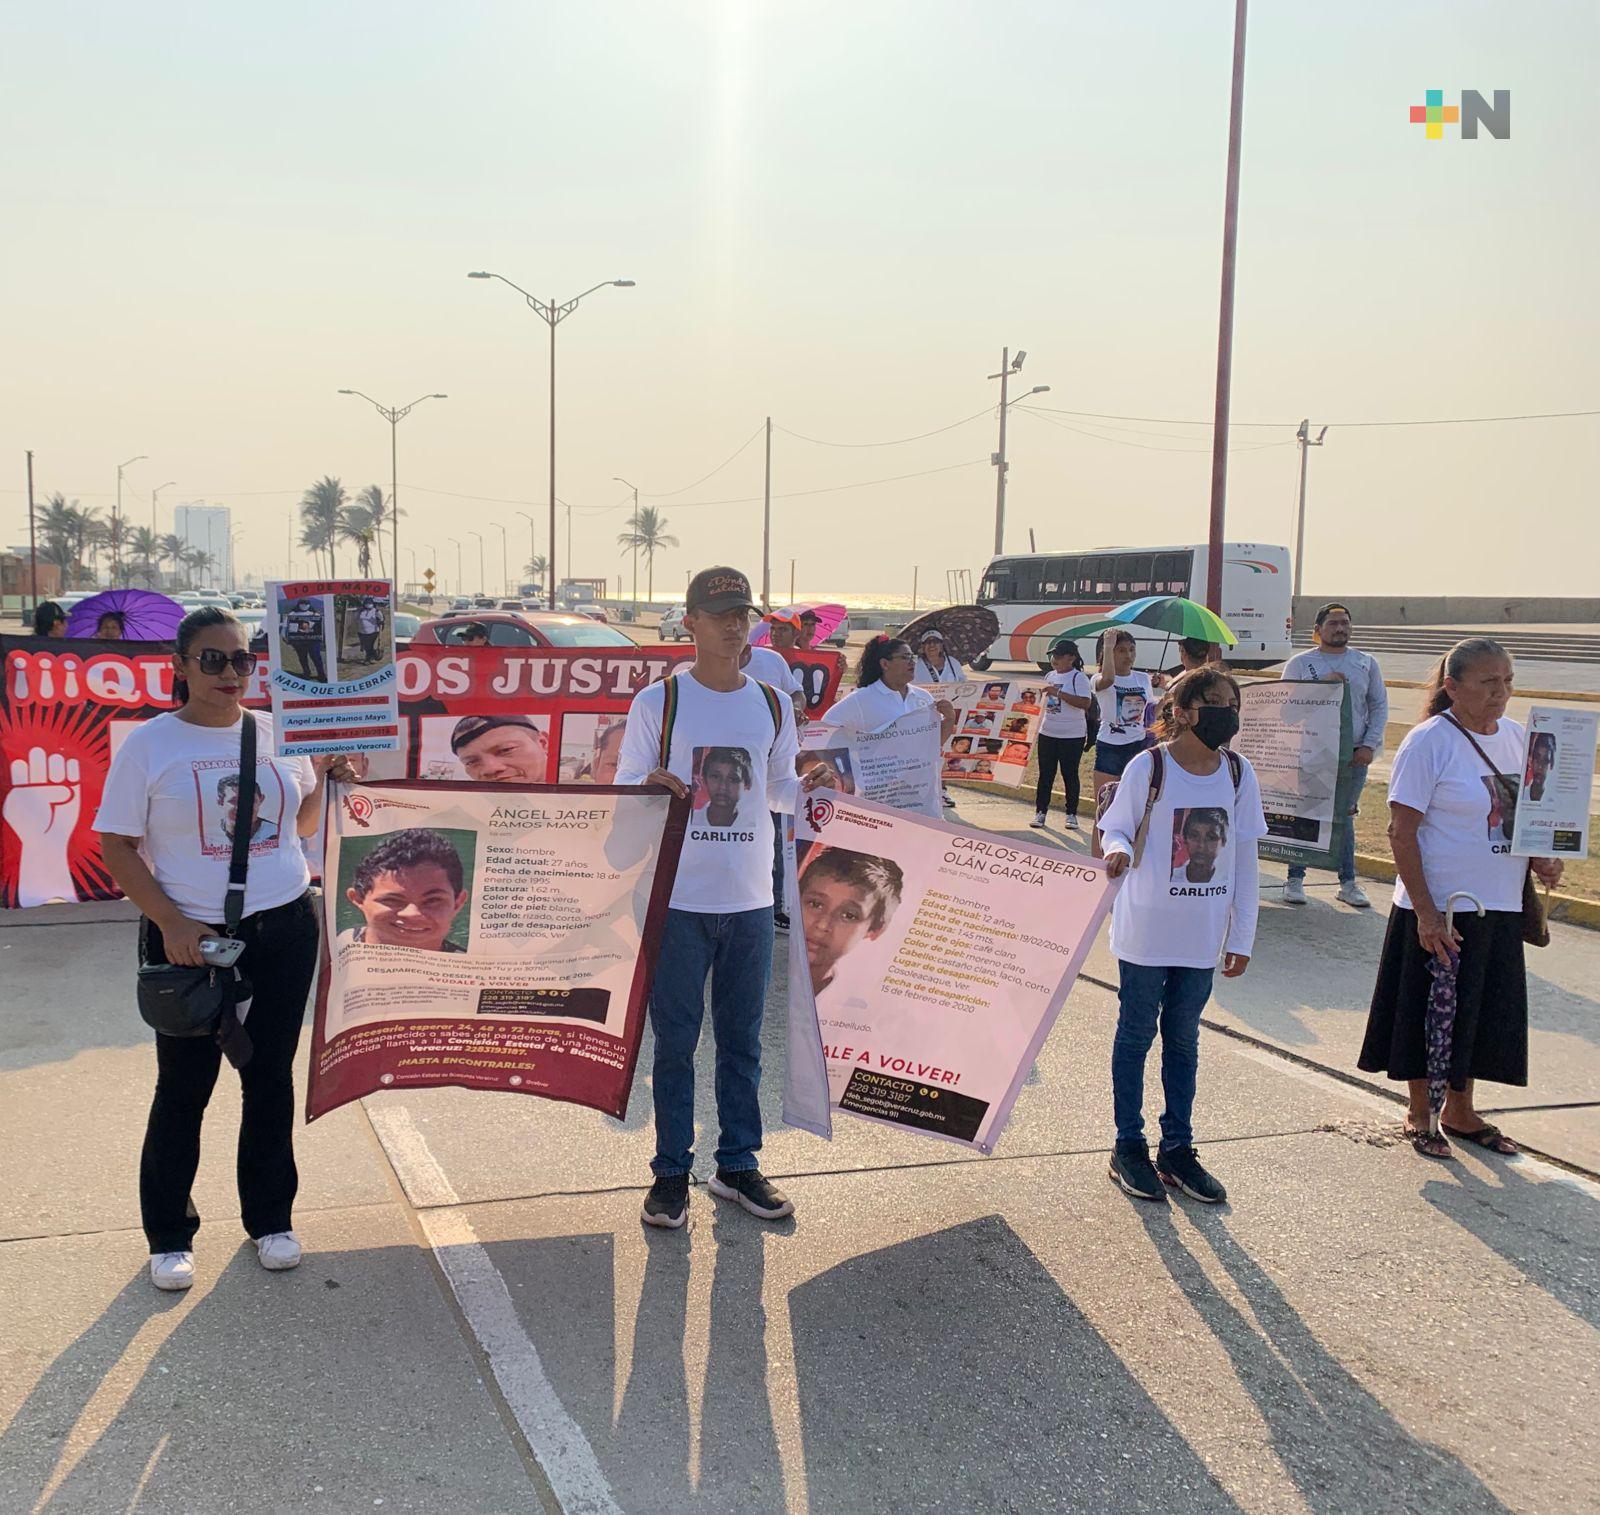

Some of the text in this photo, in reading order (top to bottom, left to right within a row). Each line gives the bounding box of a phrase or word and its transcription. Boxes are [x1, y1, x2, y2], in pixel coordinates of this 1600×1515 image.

[294, 582, 382, 594] 10 DE MAYO
[274, 670, 394, 695] NADA QUE CELEBRAR
[1246, 698, 1341, 708] ALVARADO VILLAFUERTE
[287, 713, 386, 726] Angel Jaret Ramos Mayo
[284, 742, 392, 756] En Coatzacoalcos Veracruz
[490, 806, 610, 820] ÁNGEL JARET
[837, 808, 895, 829] COMISIÓN ESTATAL
[488, 820, 589, 830] RAMOS MAYO
[690, 830, 755, 842] CARLITOS
[486, 845, 556, 856] Sexo: hombre
[1281, 847, 1304, 858] busca
[486, 856, 589, 868] Edad actual: 27 años
[944, 851, 987, 872] OLÁN
[989, 863, 1044, 887] GARCÍA
[952, 837, 1020, 863] CARLOS
[1020, 855, 1097, 883] ALBERTO
[485, 866, 516, 875] Fecha
[518, 868, 532, 876] de
[533, 869, 595, 879] nacimiento:
[511, 894, 524, 902] de
[527, 895, 550, 903] ojos:
[552, 896, 579, 904] verde
[926, 888, 991, 912] Sexo: hombre
[1169, 885, 1228, 897] CARLITOS
[481, 902, 581, 914] Color de piel: blanca
[481, 911, 520, 920] Cabello:
[921, 898, 1016, 930] Edad actual: 12 años
[480, 920, 593, 931] Lugar de desaparición:
[913, 917, 956, 935] Estatura:
[917, 908, 1070, 956] Fecha de nacimiento: 19/02/2008
[479, 930, 549, 940] Coatzacoalcos,
[908, 927, 1017, 960] Color de ojos: café claro
[903, 937, 1027, 976] Color de piel: moreno claro
[893, 955, 1001, 989] Lugar de desaparición:
[898, 946, 1051, 995] Cabello: castaño claro, lacio, corto
[883, 976, 992, 1009] Fecha de desaparición:
[954, 980, 971, 991] Ver
[880, 984, 976, 1014] 15 de febrero de 2020
[335, 1037, 347, 1049] es
[349, 1024, 406, 1041] necesario
[408, 1023, 455, 1032] esperar
[458, 1023, 475, 1032] 24,
[479, 1024, 495, 1032] 48
[511, 1026, 525, 1034] 72
[528, 1026, 562, 1038] horas,
[566, 1030, 576, 1039] si
[579, 1032, 611, 1049] tienes
[613, 1043, 628, 1055] un
[318, 1043, 382, 1077] desaparecida
[386, 1039, 417, 1050] llama
[432, 1037, 443, 1045] la
[447, 1037, 500, 1047] Comisión
[504, 1039, 547, 1051] Estatal
[549, 1044, 565, 1054] de
[569, 1046, 625, 1071] Búsqueda
[319, 1043, 353, 1068] familiar
[354, 1029, 427, 1048] desaparecido
[439, 1030, 471, 1039] sabes
[473, 1030, 491, 1040] del
[494, 1032, 542, 1044] paradero
[544, 1034, 559, 1044] de
[561, 1039, 582, 1049] una
[584, 1043, 626, 1063] persona
[408, 1045, 463, 1053] Veracruz:
[397, 1056, 536, 1071] ¡HASTA ENCONTRARLES!
[856, 1051, 870, 1064] A
[879, 1054, 962, 1086] VOLVER!
[853, 1071, 916, 1094] CONTACTO
[849, 1080, 912, 1104] 228 319 3187
[843, 1098, 900, 1119] Emergencias 911
